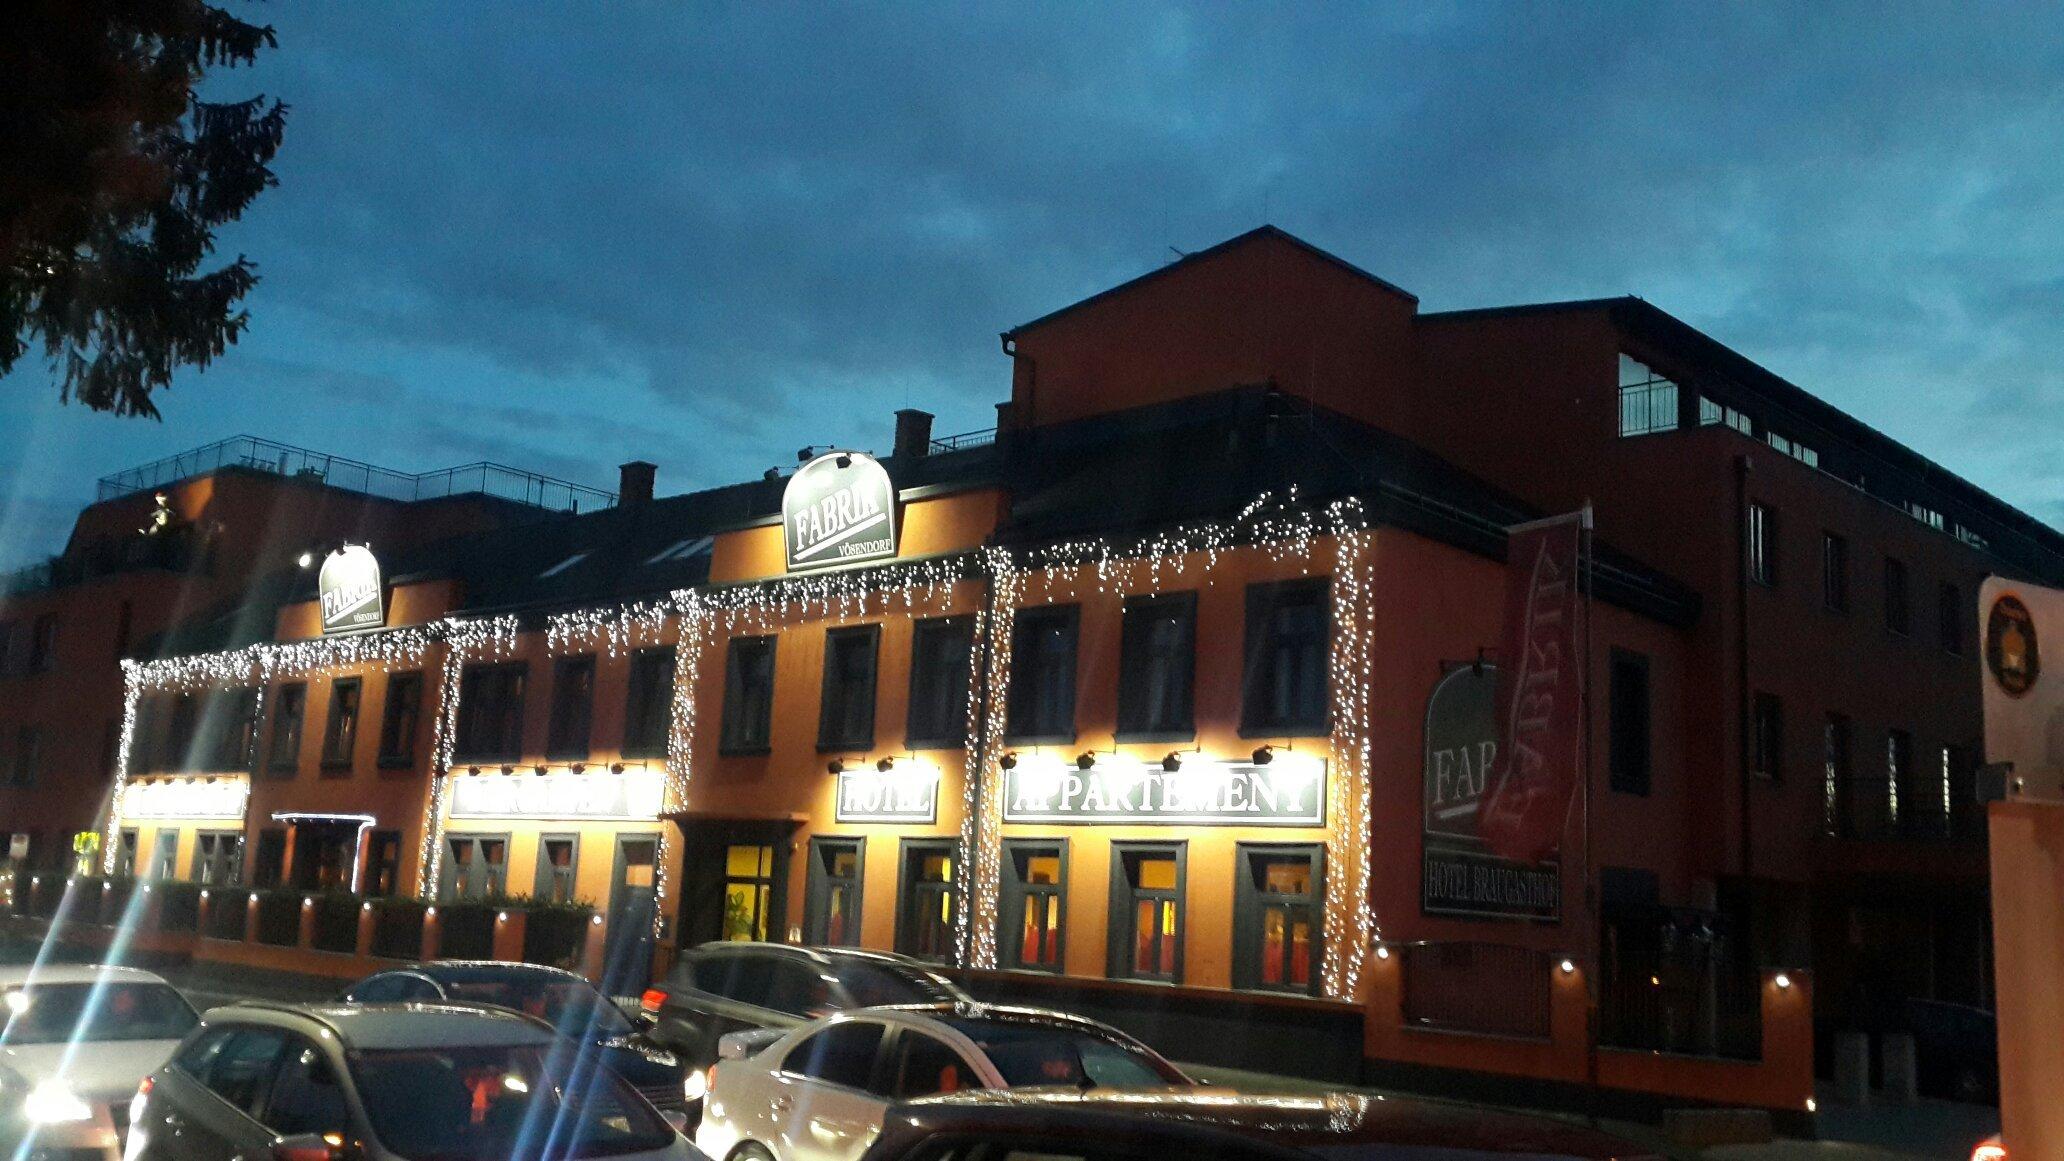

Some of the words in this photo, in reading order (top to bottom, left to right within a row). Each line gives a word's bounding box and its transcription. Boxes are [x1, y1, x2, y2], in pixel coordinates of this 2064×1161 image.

[794, 484, 879, 551] FABRIK
[838, 538, 891, 557] VÖSENDORF
[843, 778, 930, 812] HOTEL
[1429, 861, 1469, 900] HOTEL
